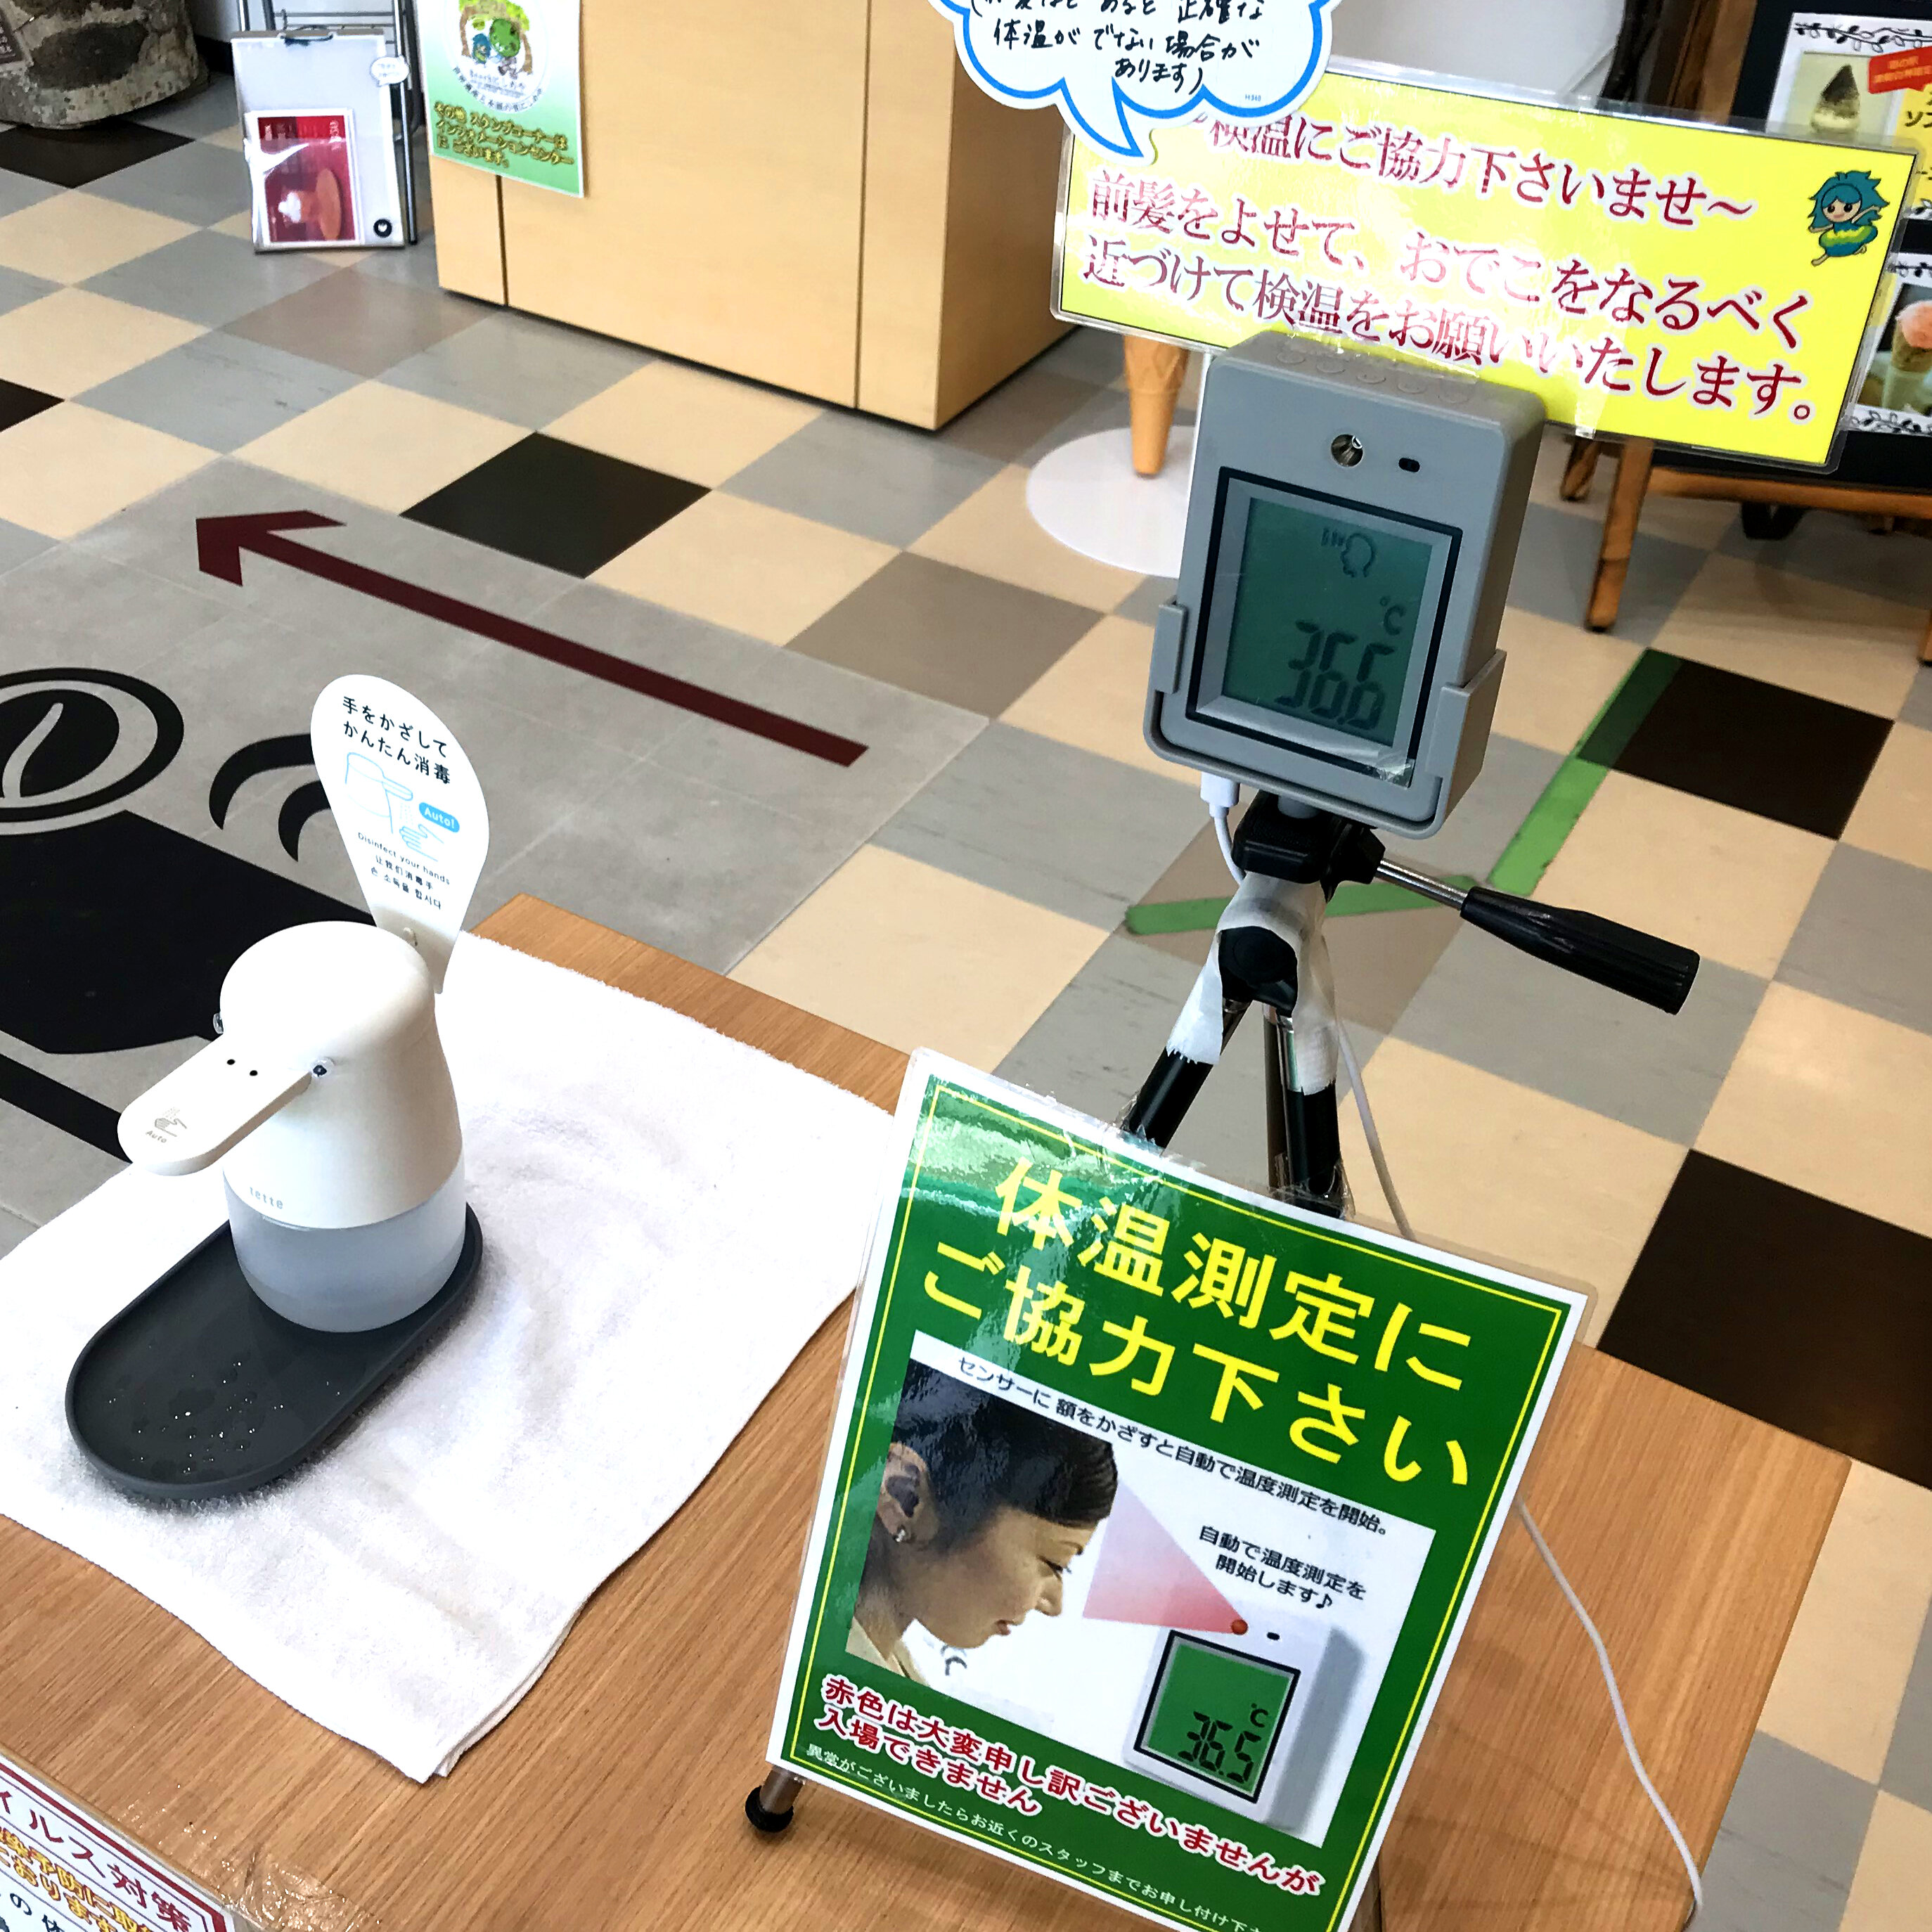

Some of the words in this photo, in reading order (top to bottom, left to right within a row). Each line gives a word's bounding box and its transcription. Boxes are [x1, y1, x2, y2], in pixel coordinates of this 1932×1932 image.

[1083, 235, 1810, 420] 近づけて検温をお願いいたします。
[342, 696, 447, 758] 手をかざして
[343, 721, 451, 785] かんたん消毒
[424, 807, 455, 829] Auto!
[358, 832, 397, 857] Disinfect
[400, 856, 420, 869] your
[423, 865, 450, 885] hands
[146, 1130, 167, 1143] Auto
[994, 1157, 1471, 1392] 体温測定に
[922, 1241, 1468, 1487] ご協力下さい
[1199, 1525, 1367, 1601] 自動で温度測定を
[818, 1708, 1038, 1813] 入場できません
[1178, 1711, 1261, 1784] 36.5
[825, 1677, 1320, 1893] 赤色は大変申し訳ございませんが
